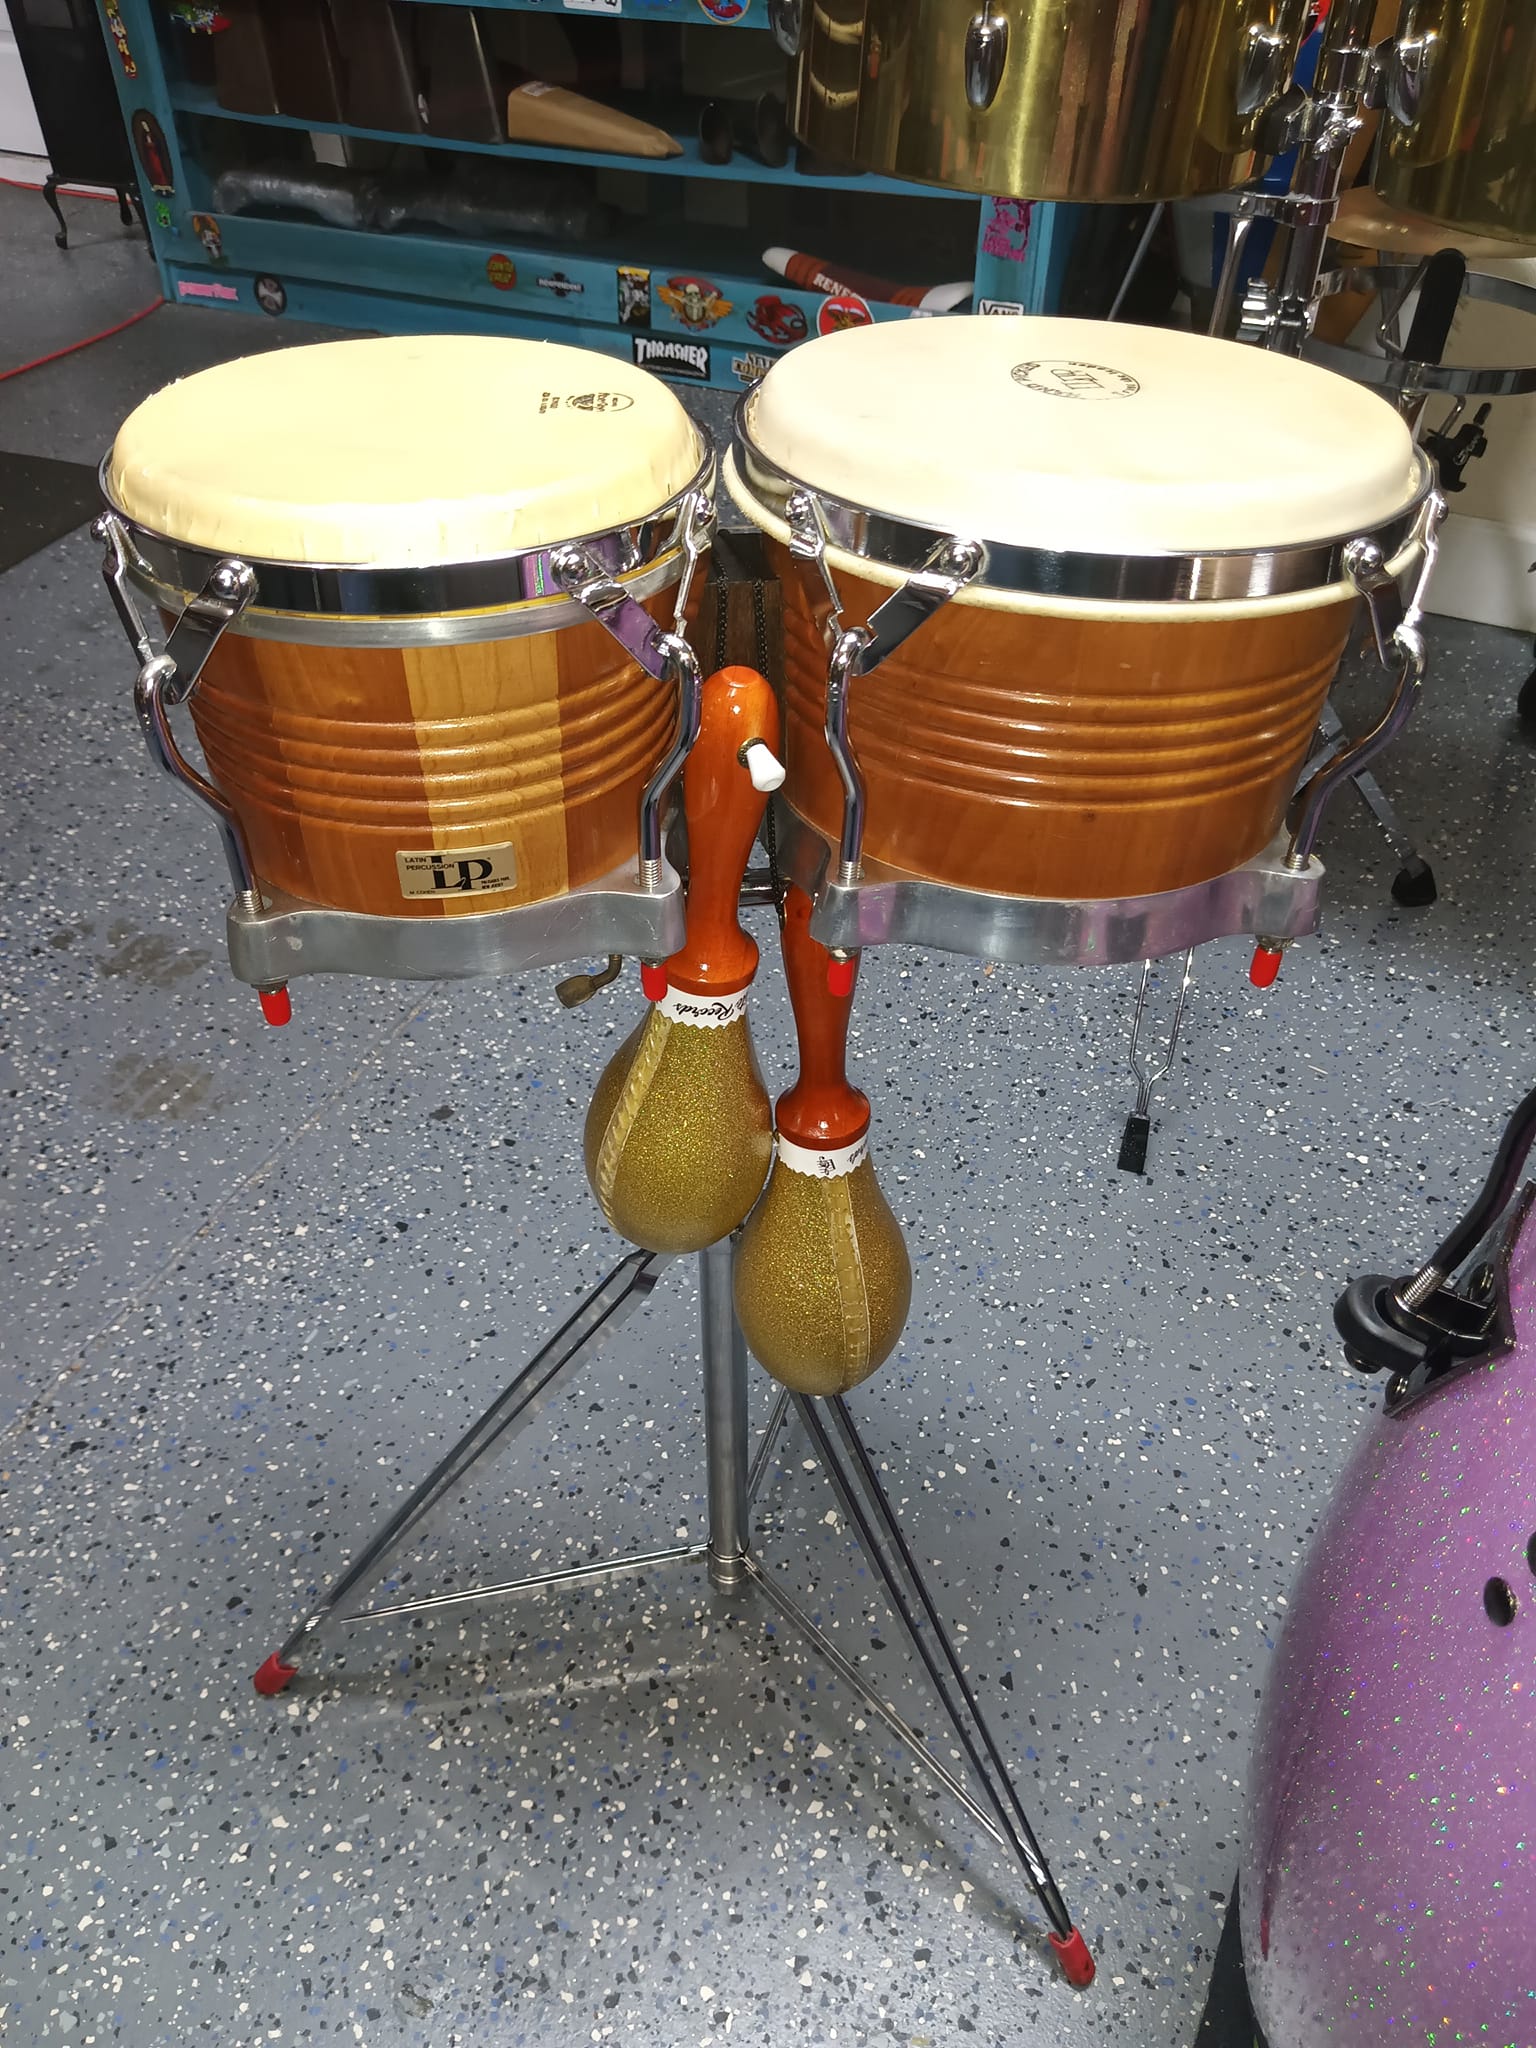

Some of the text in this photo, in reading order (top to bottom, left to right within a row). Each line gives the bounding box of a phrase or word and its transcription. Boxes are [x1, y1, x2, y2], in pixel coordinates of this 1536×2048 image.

[634, 337, 709, 374] THRASHER
[404, 856, 427, 864] LATIN
[406, 863, 455, 872] PERCUSSION
[430, 855, 493, 890] LP
[673, 1001, 734, 1022] Records
